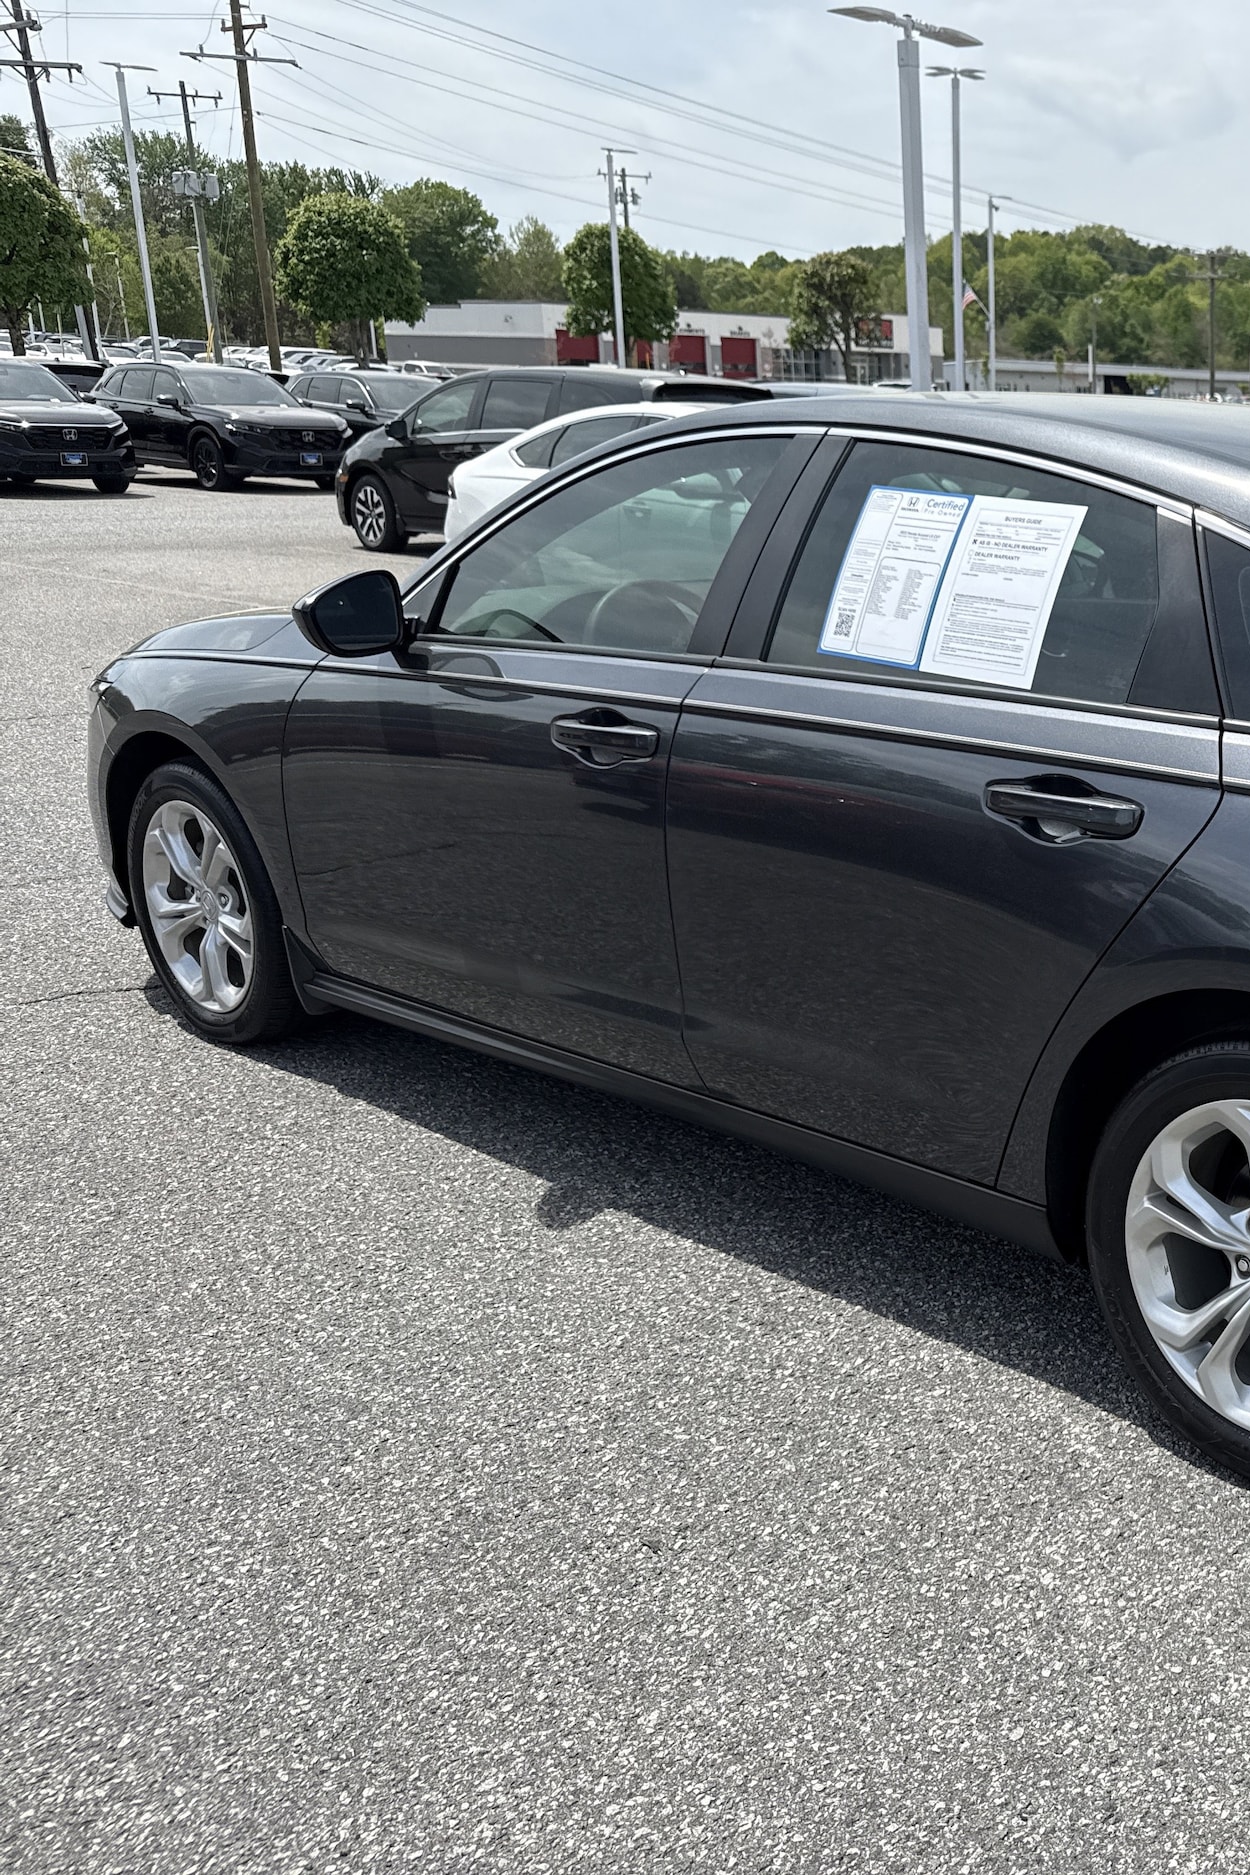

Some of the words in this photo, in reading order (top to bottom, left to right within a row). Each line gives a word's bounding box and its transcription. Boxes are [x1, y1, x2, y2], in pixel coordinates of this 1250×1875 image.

[927, 499, 966, 511] Certified
[1021, 544, 1048, 552] WARRANTY
[975, 551, 993, 559] DEALER
[994, 553, 1020, 561] WARRANTY
